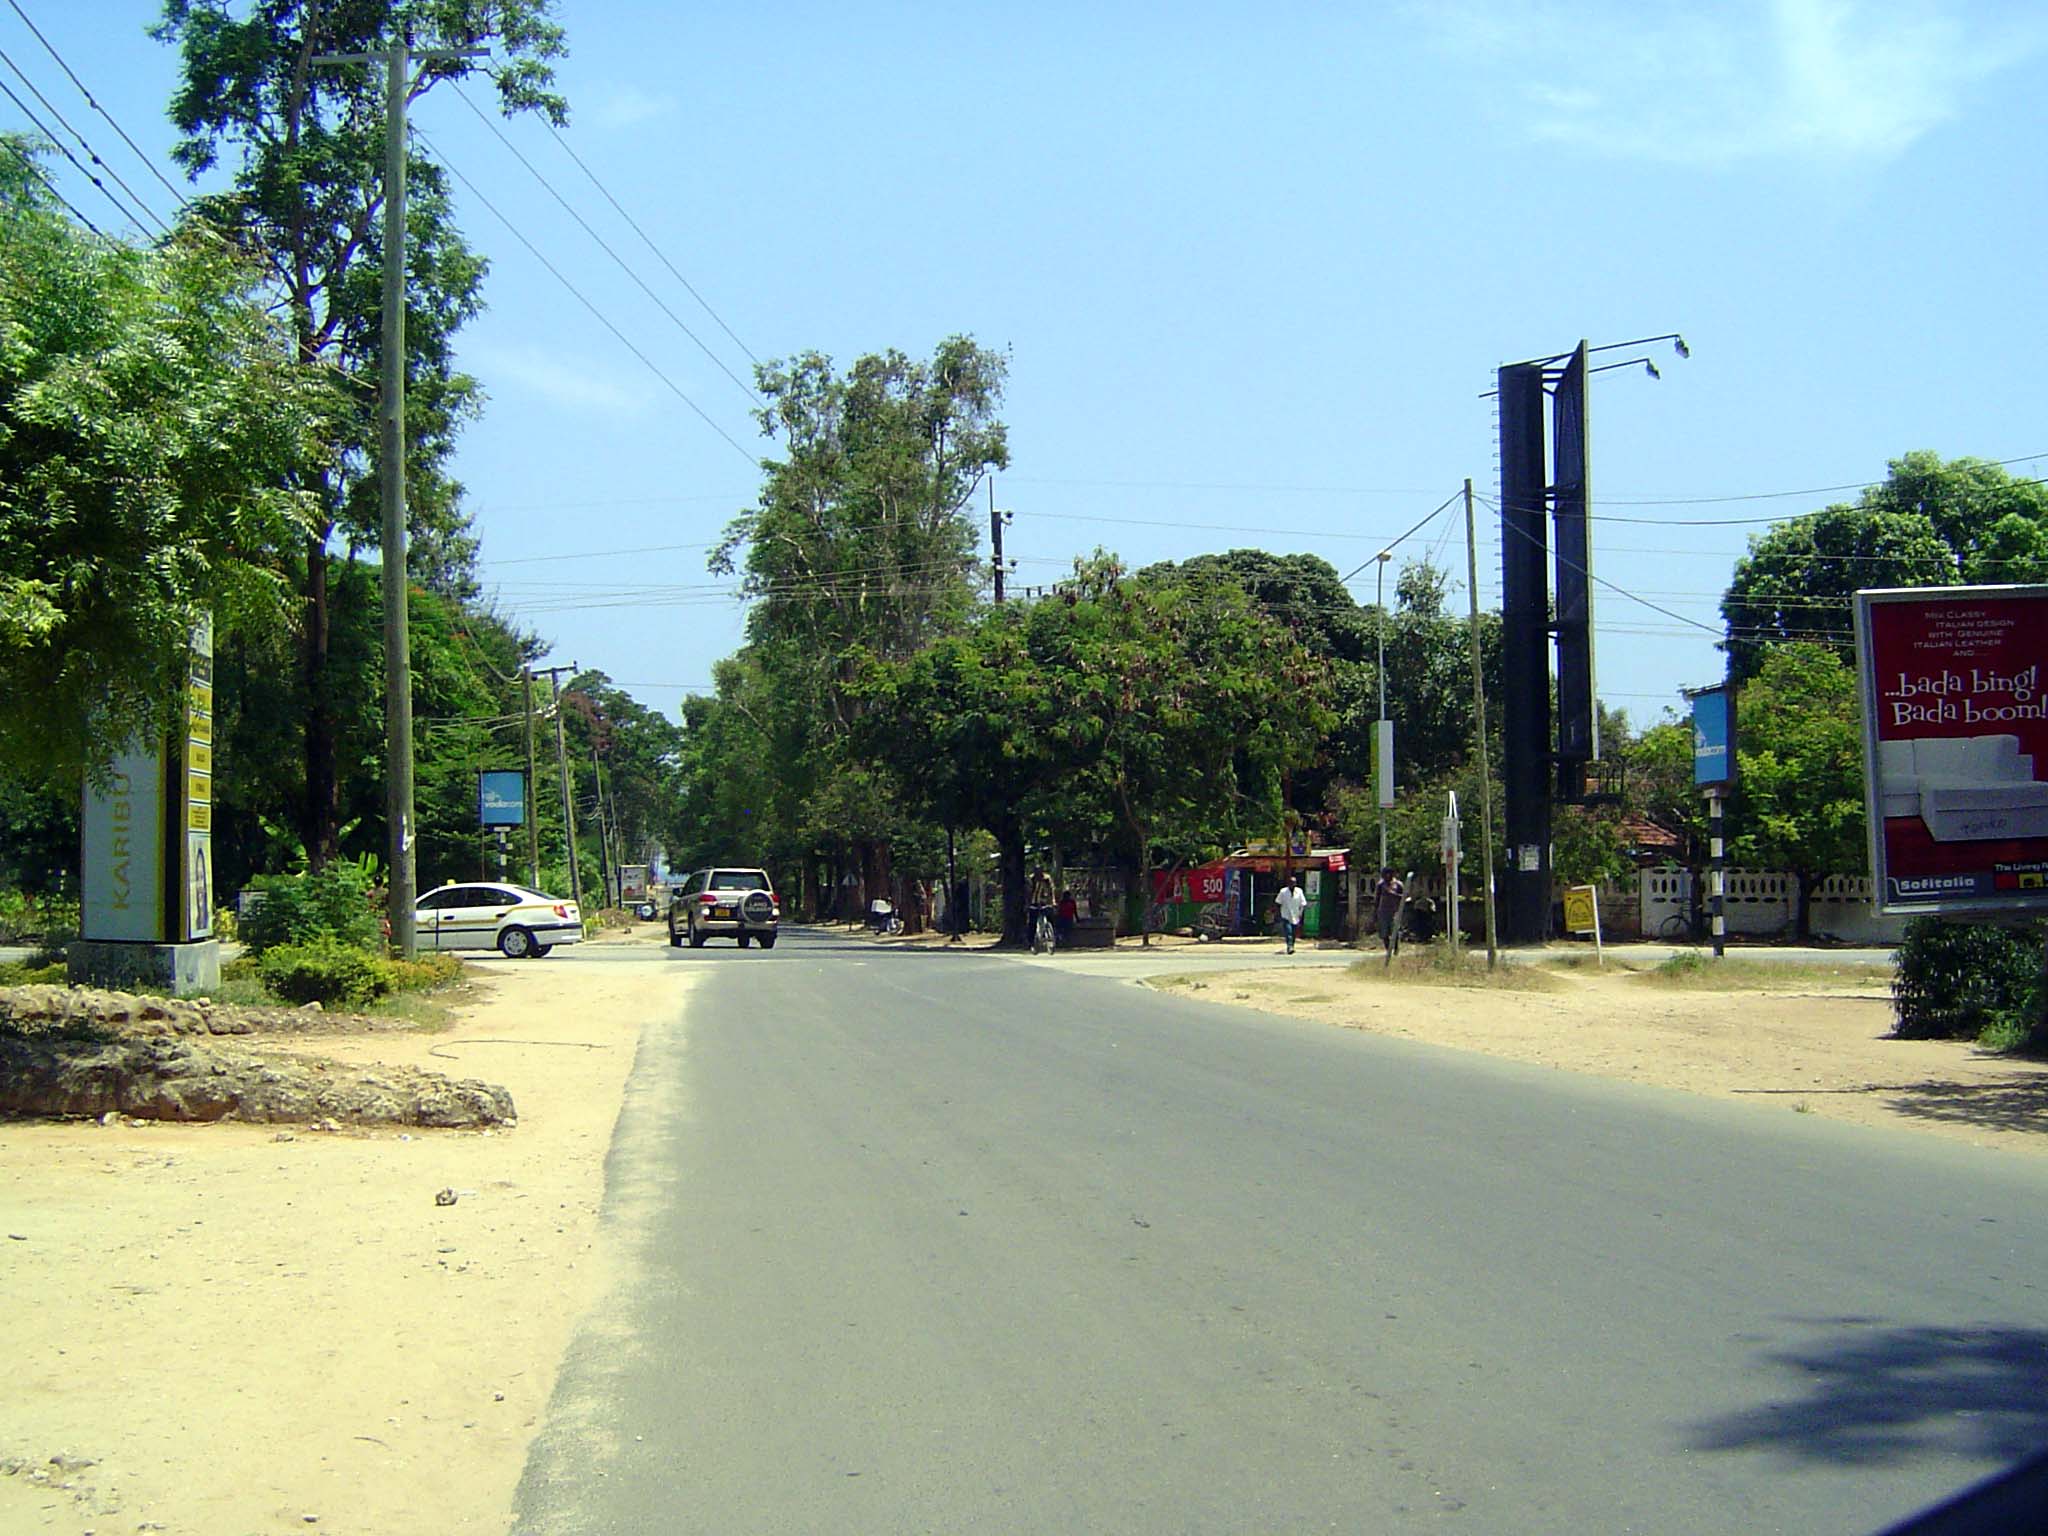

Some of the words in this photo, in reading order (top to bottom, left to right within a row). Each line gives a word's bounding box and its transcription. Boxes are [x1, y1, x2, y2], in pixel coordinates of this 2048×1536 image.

[1955, 639, 2001, 647] LEATHER
[1970, 665, 2036, 701] bing!
[1891, 698, 1957, 726] Bada
[1963, 694, 2047, 723] boom!
[112, 772, 129, 910] KARIBU
[1203, 878, 1223, 893] 500
